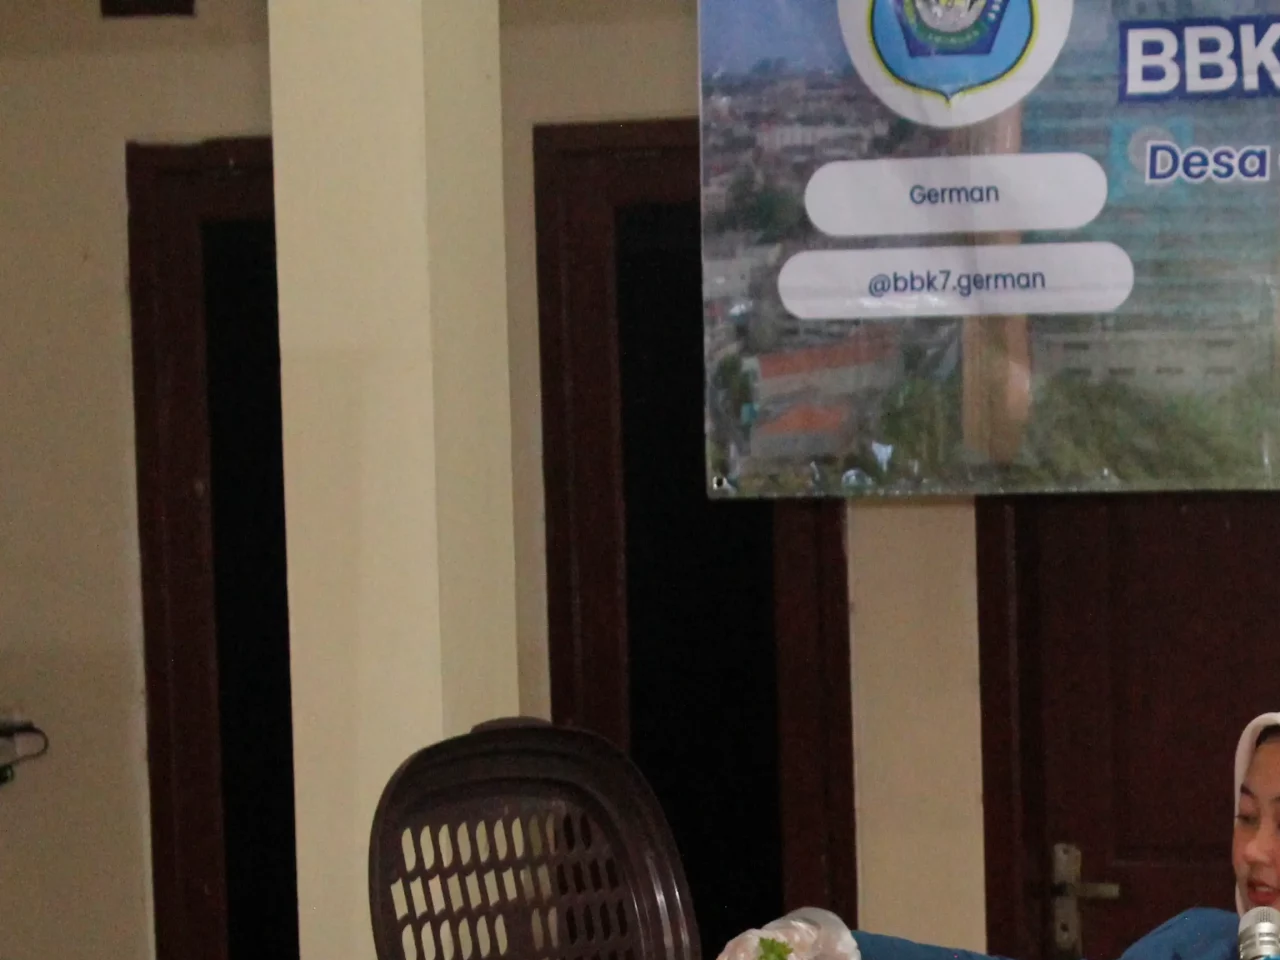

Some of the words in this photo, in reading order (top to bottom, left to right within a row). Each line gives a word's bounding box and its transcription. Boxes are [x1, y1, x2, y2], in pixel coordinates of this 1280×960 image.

[1149, 143, 1267, 180] Desa
[909, 184, 1000, 205] German
[868, 269, 1047, 298] @bbk7.german
